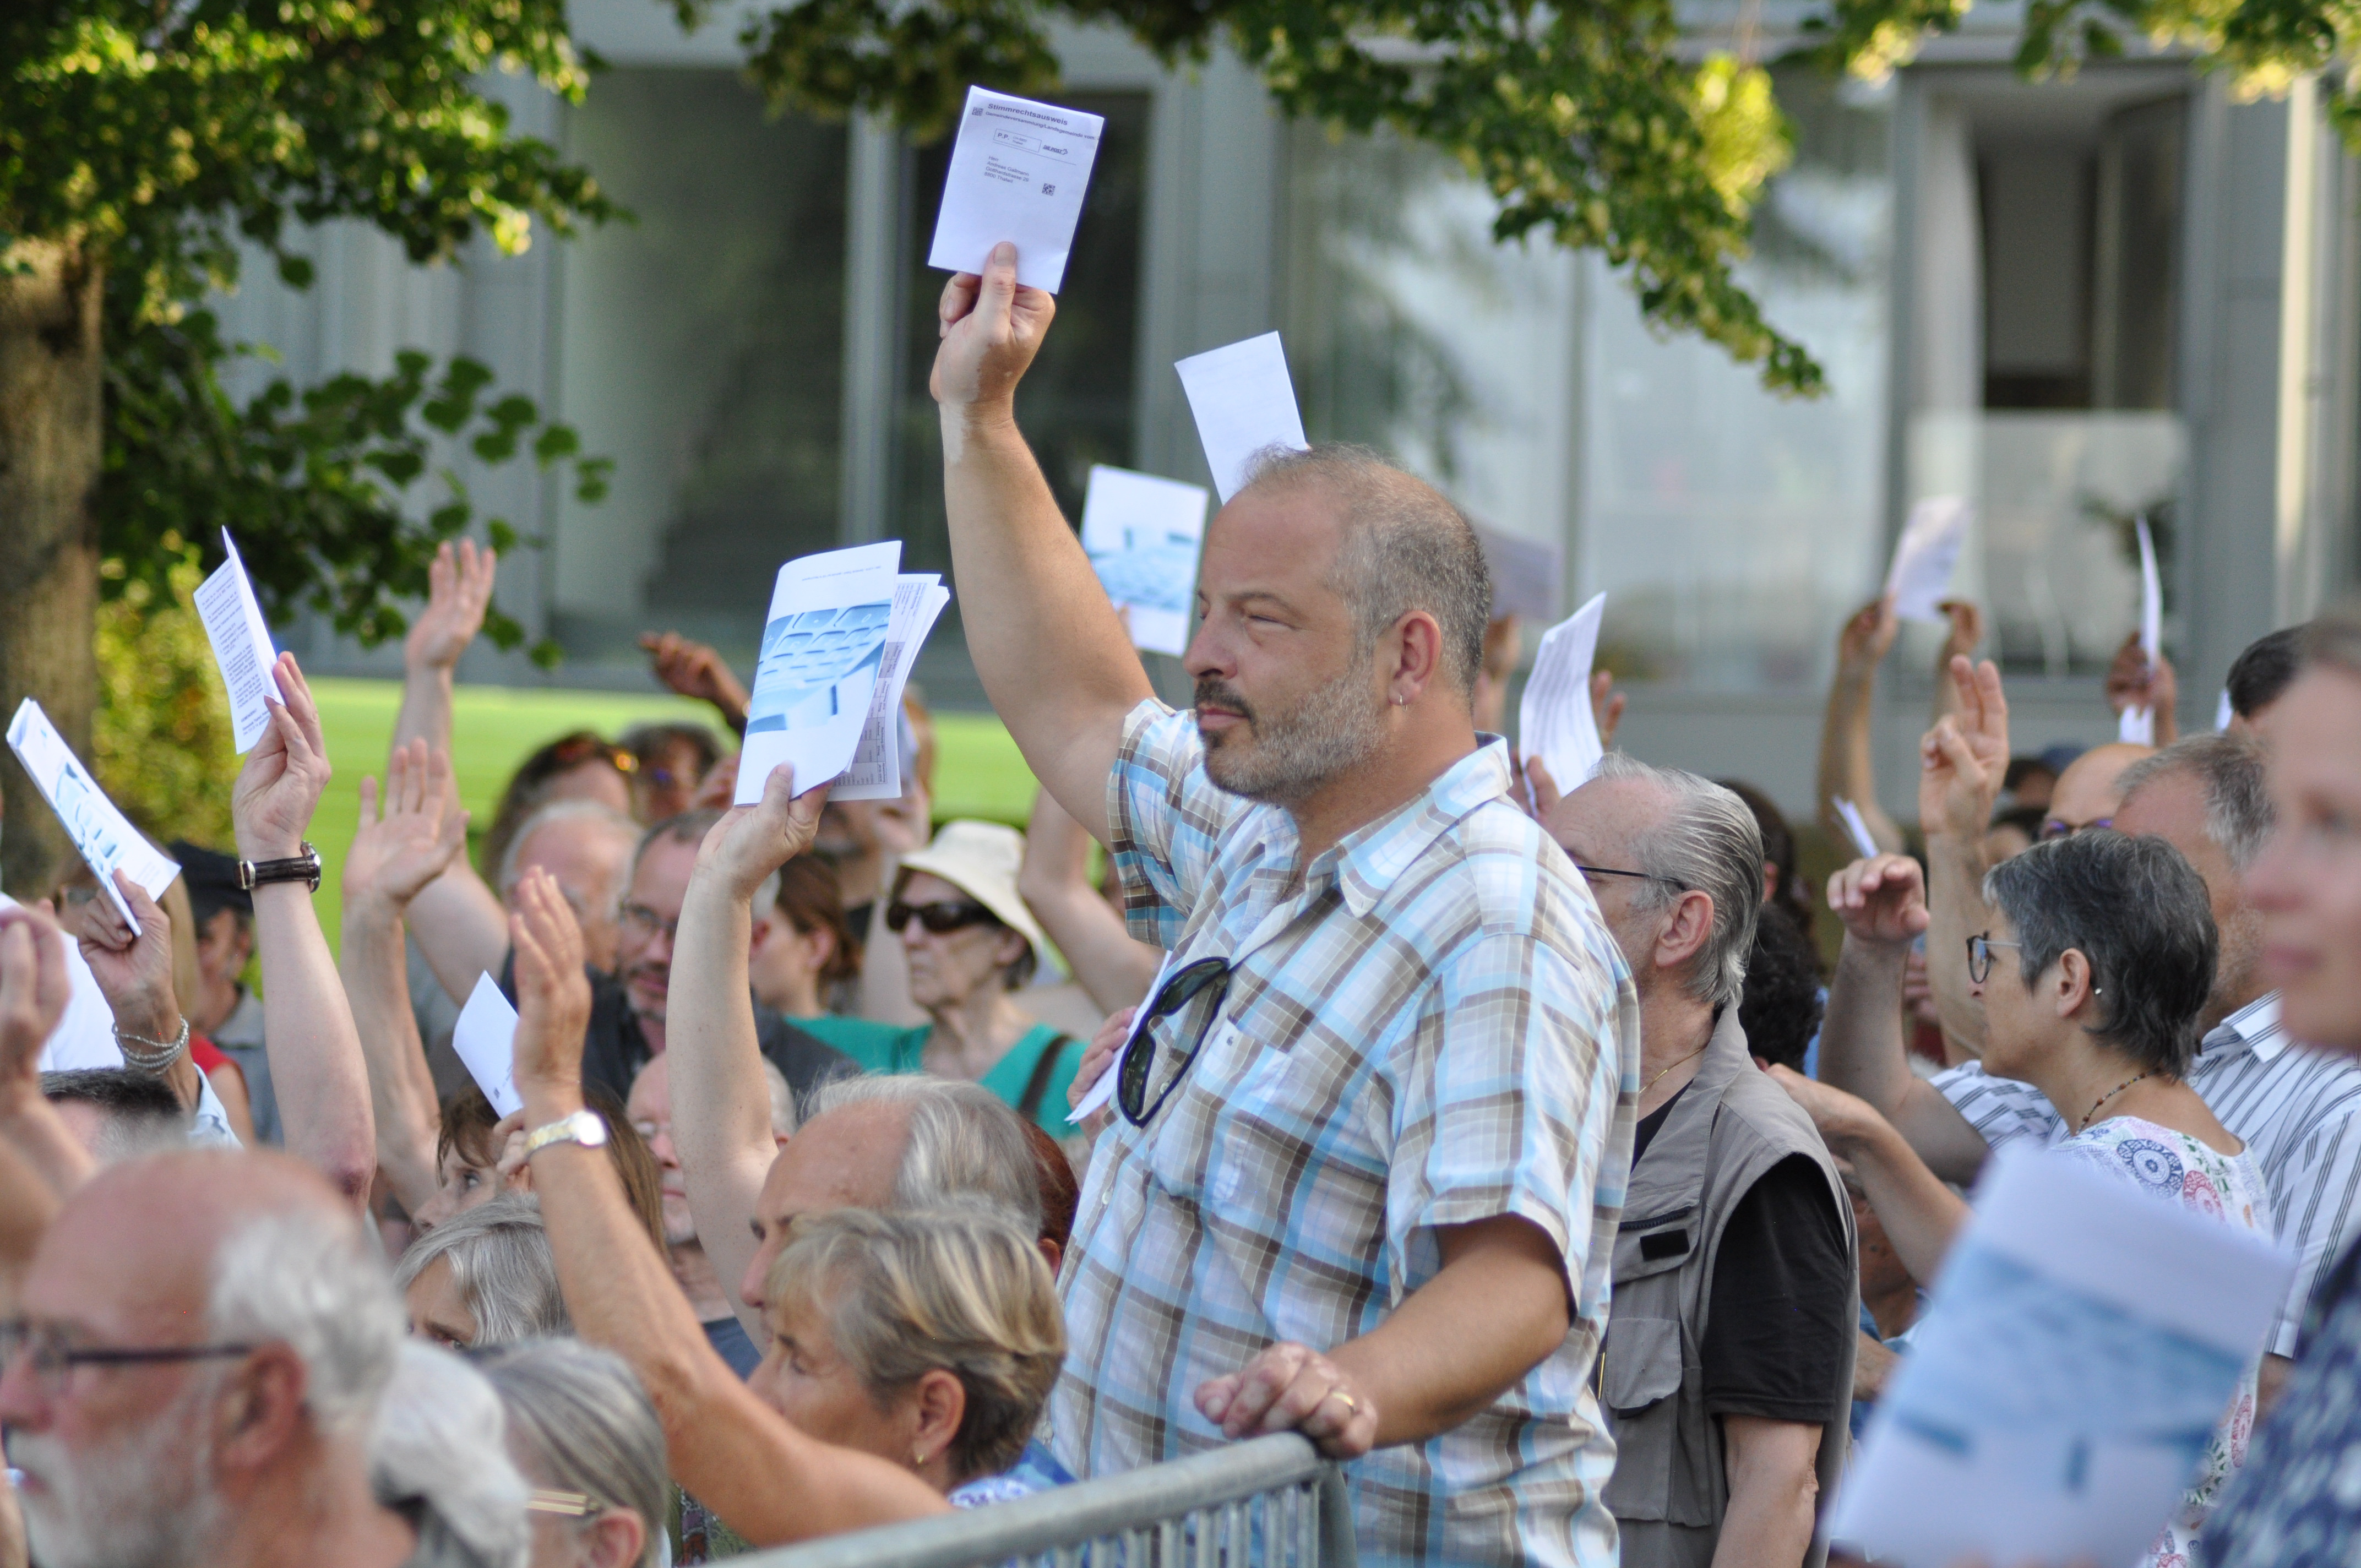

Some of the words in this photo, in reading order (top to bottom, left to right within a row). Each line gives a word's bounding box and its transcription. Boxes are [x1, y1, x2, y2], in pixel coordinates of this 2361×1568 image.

[988, 103, 1068, 126] Stimmrechtsausweis
[986, 111, 1083, 138] Gemeindeversammlung/Landsgemeinde
[1051, 146, 1063, 154] POST
[987, 161, 1007, 170] Andreas
[986, 166, 1022, 181] Gotthardstrasse
